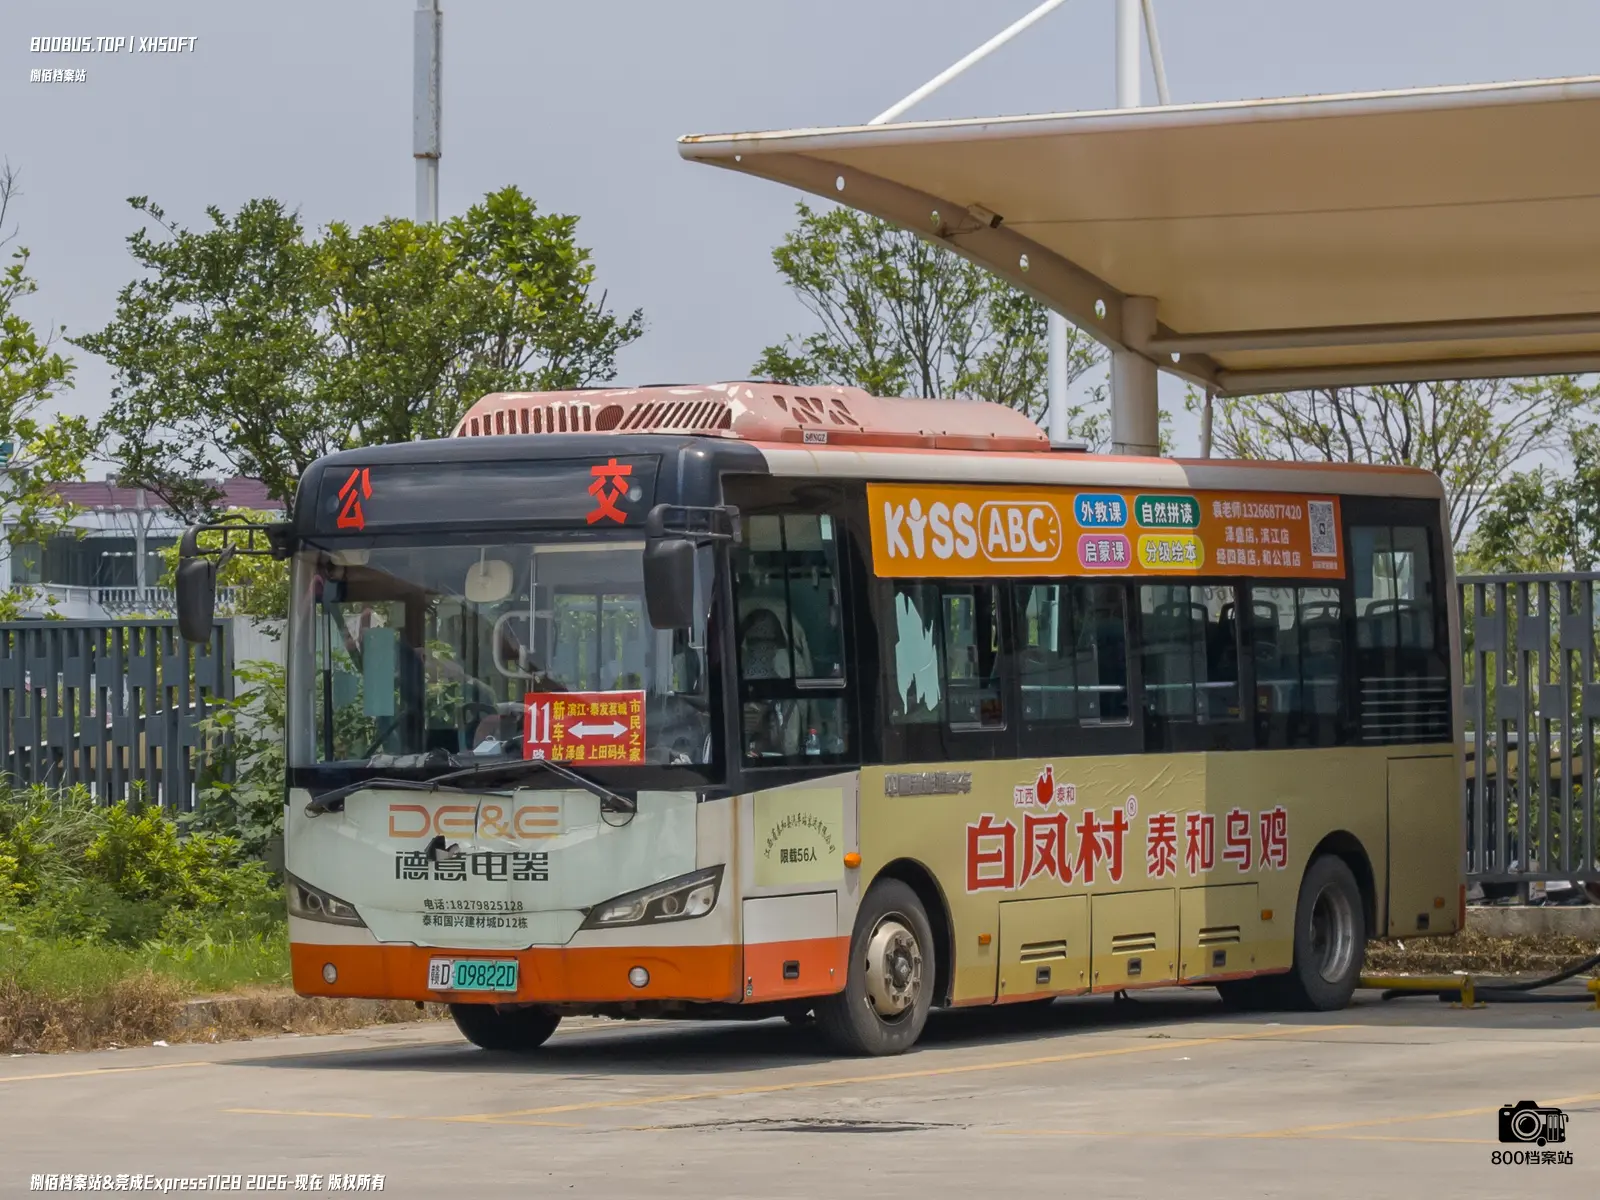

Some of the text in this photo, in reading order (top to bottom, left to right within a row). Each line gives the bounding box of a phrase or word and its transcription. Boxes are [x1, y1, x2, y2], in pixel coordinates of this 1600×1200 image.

[1081, 500, 1122, 523] 外教课
[1141, 501, 1194, 524] 自然拼读
[987, 507, 1048, 553] ABC
[1084, 540, 1126, 563] 启蒙课
[1145, 540, 1198, 564] 分级绘本
[527, 702, 552, 744] 11
[629, 699, 641, 762] 市民之家
[588, 744, 627, 760] 上田码头
[1015, 786, 1075, 805] 江西 泰和
[780, 846, 818, 864] 限载56人
[966, 805, 1289, 893] 白凤村 泰和乌鸡
[422, 914, 529, 930] 泰和国兴建材城D12栋
[457, 964, 516, 987] 09822D
